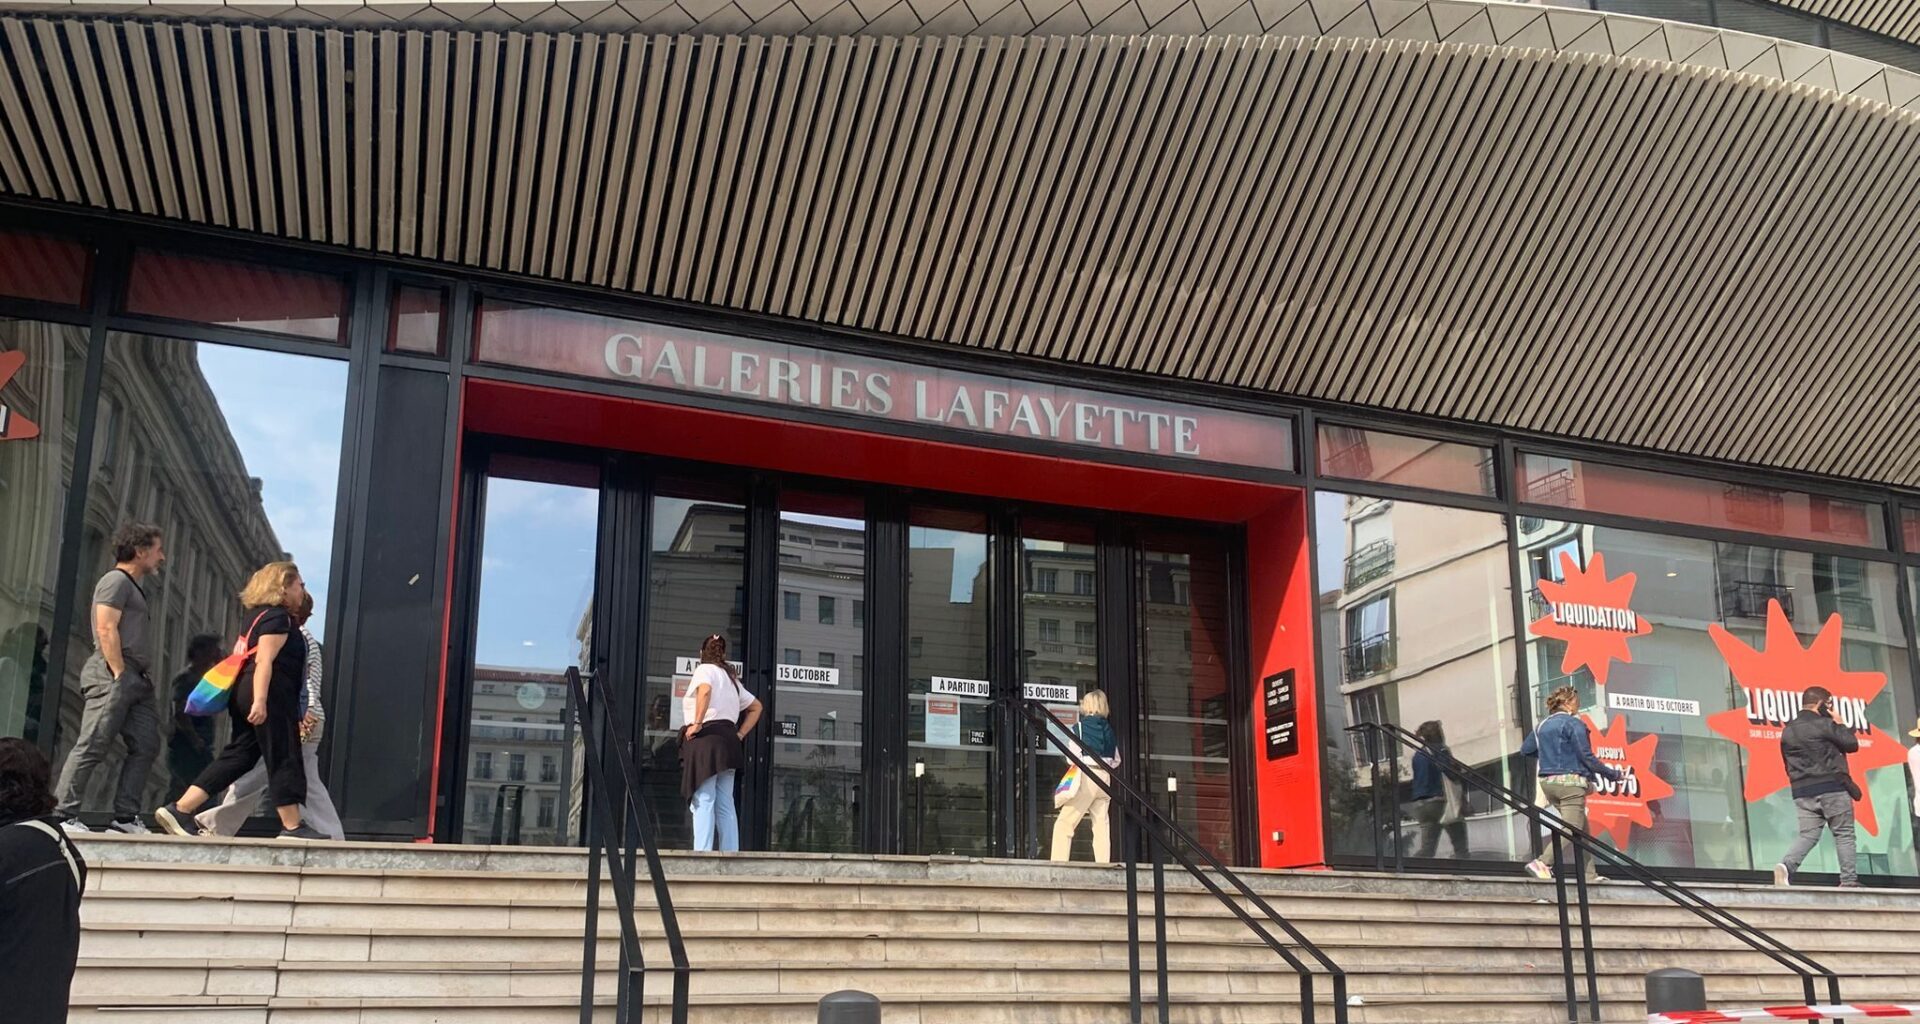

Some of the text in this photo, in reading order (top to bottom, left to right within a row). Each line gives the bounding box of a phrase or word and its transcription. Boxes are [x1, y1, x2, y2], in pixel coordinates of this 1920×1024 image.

[604, 332, 1200, 455] GALERIES LAFAYETTE
[1552, 602, 1637, 632] LIQUIDATION
[779, 667, 831, 682] 15 OCTOBRE
[939, 678, 989, 695] À PARTIR DU
[1024, 686, 1070, 699] 15 OCTOBRE
[1622, 697, 1645, 709] PARTIR
[1646, 698, 1655, 710] DU
[1657, 701, 1666, 711] 15
[1666, 702, 1695, 714] OCTOBRE
